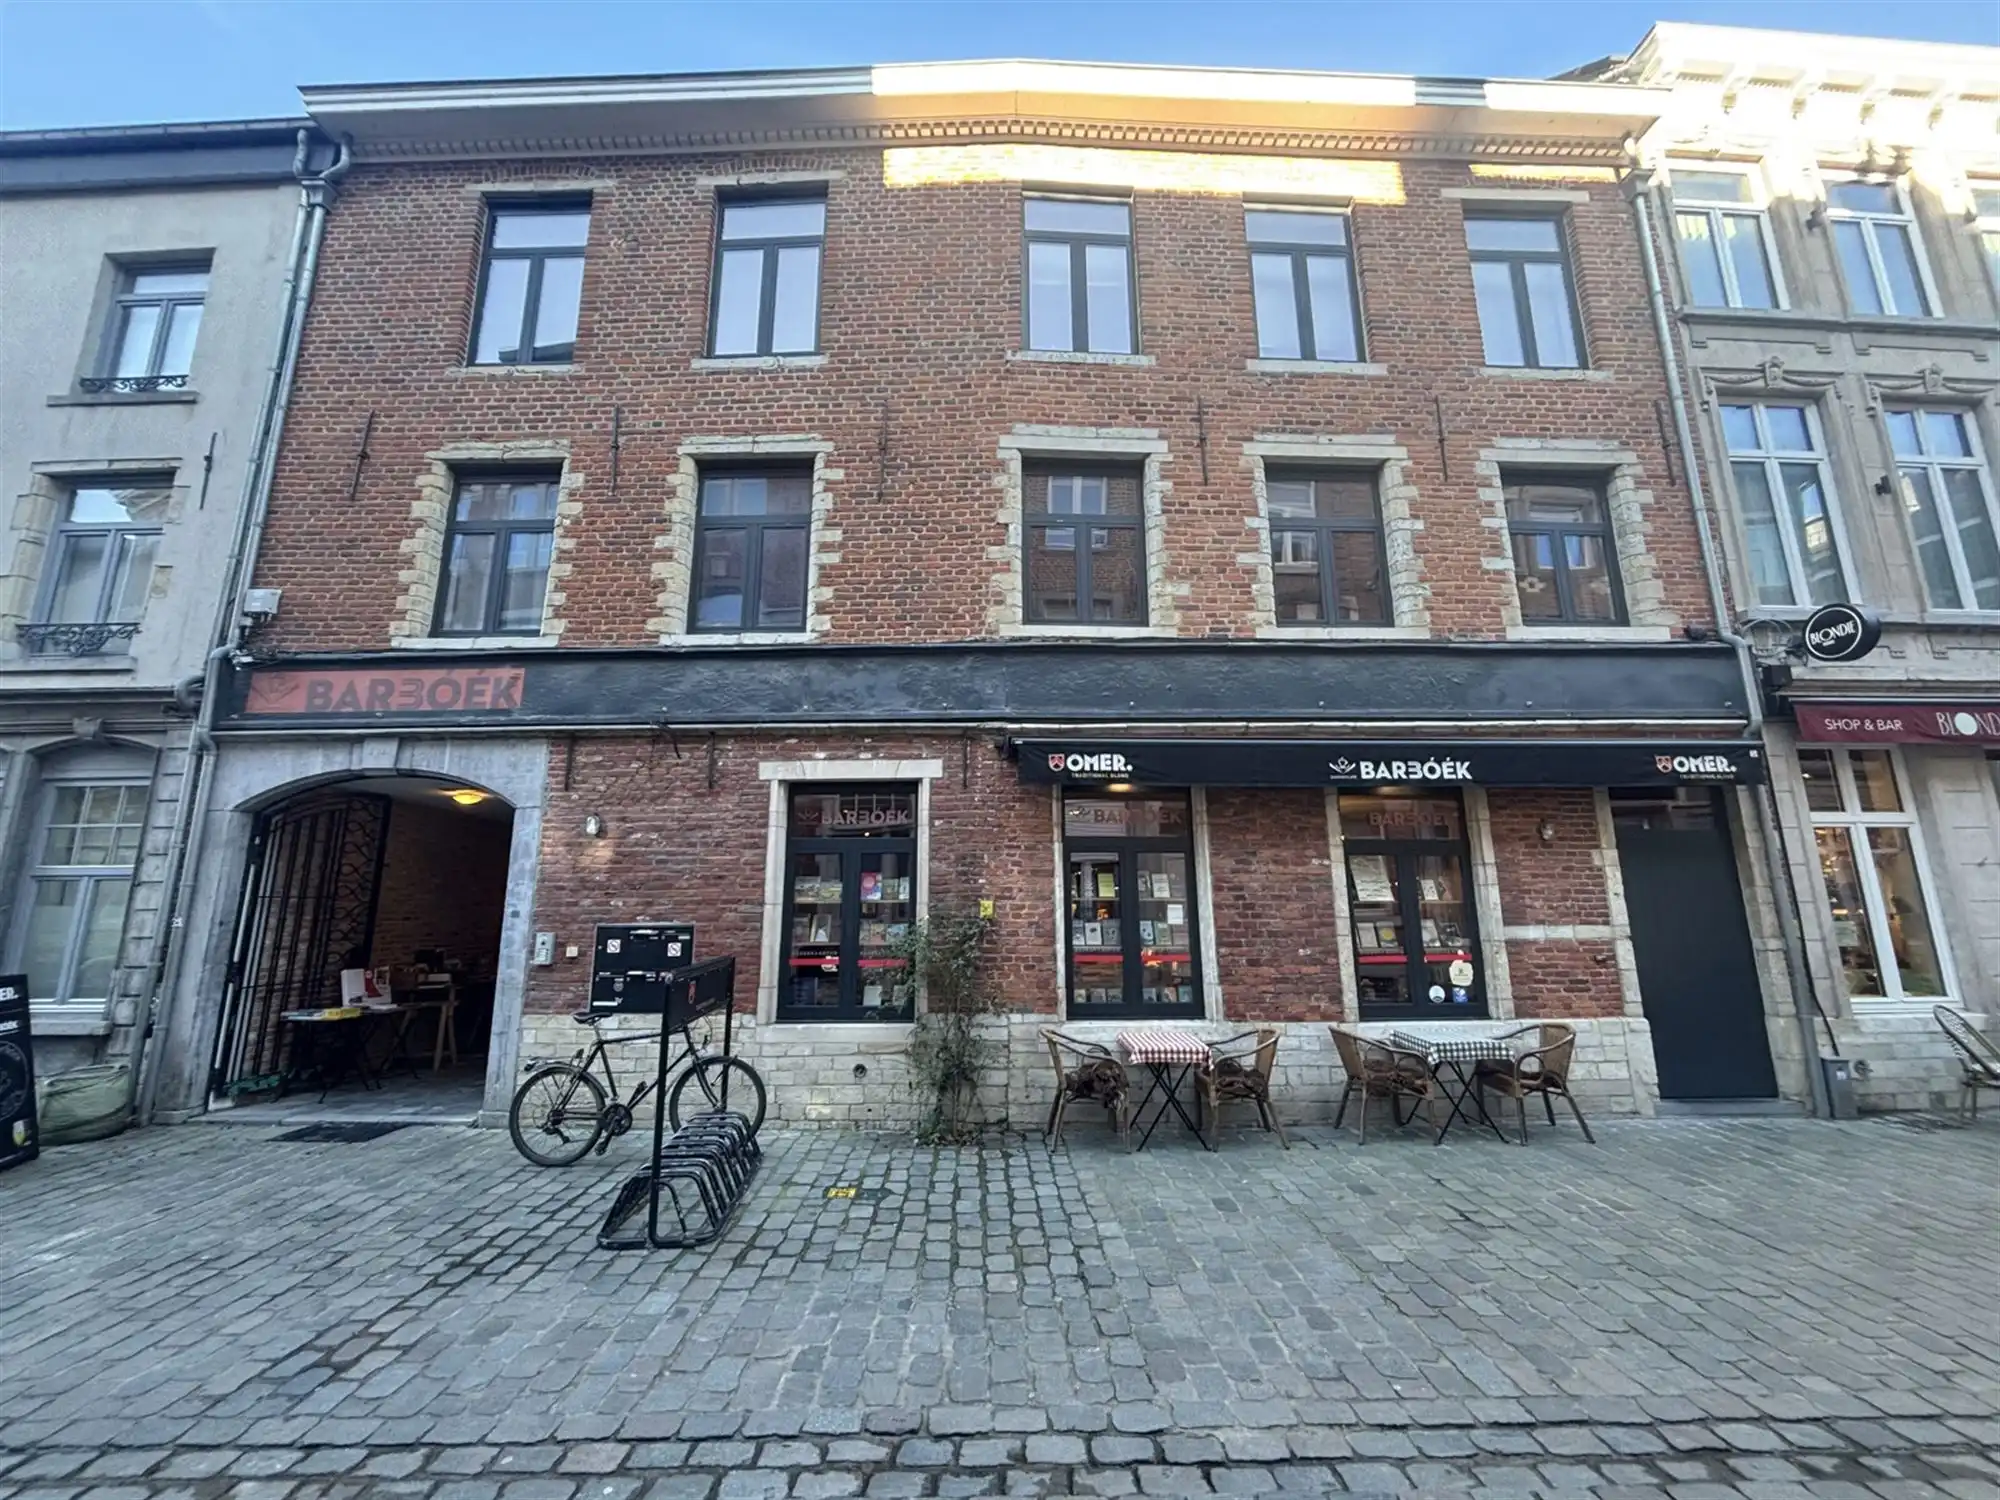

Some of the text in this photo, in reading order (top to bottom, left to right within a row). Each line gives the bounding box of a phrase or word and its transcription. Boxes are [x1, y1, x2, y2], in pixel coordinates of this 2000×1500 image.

[1809, 620, 1856, 646] BLONDIE
[1824, 718, 1904, 731] SHOP & BAR
